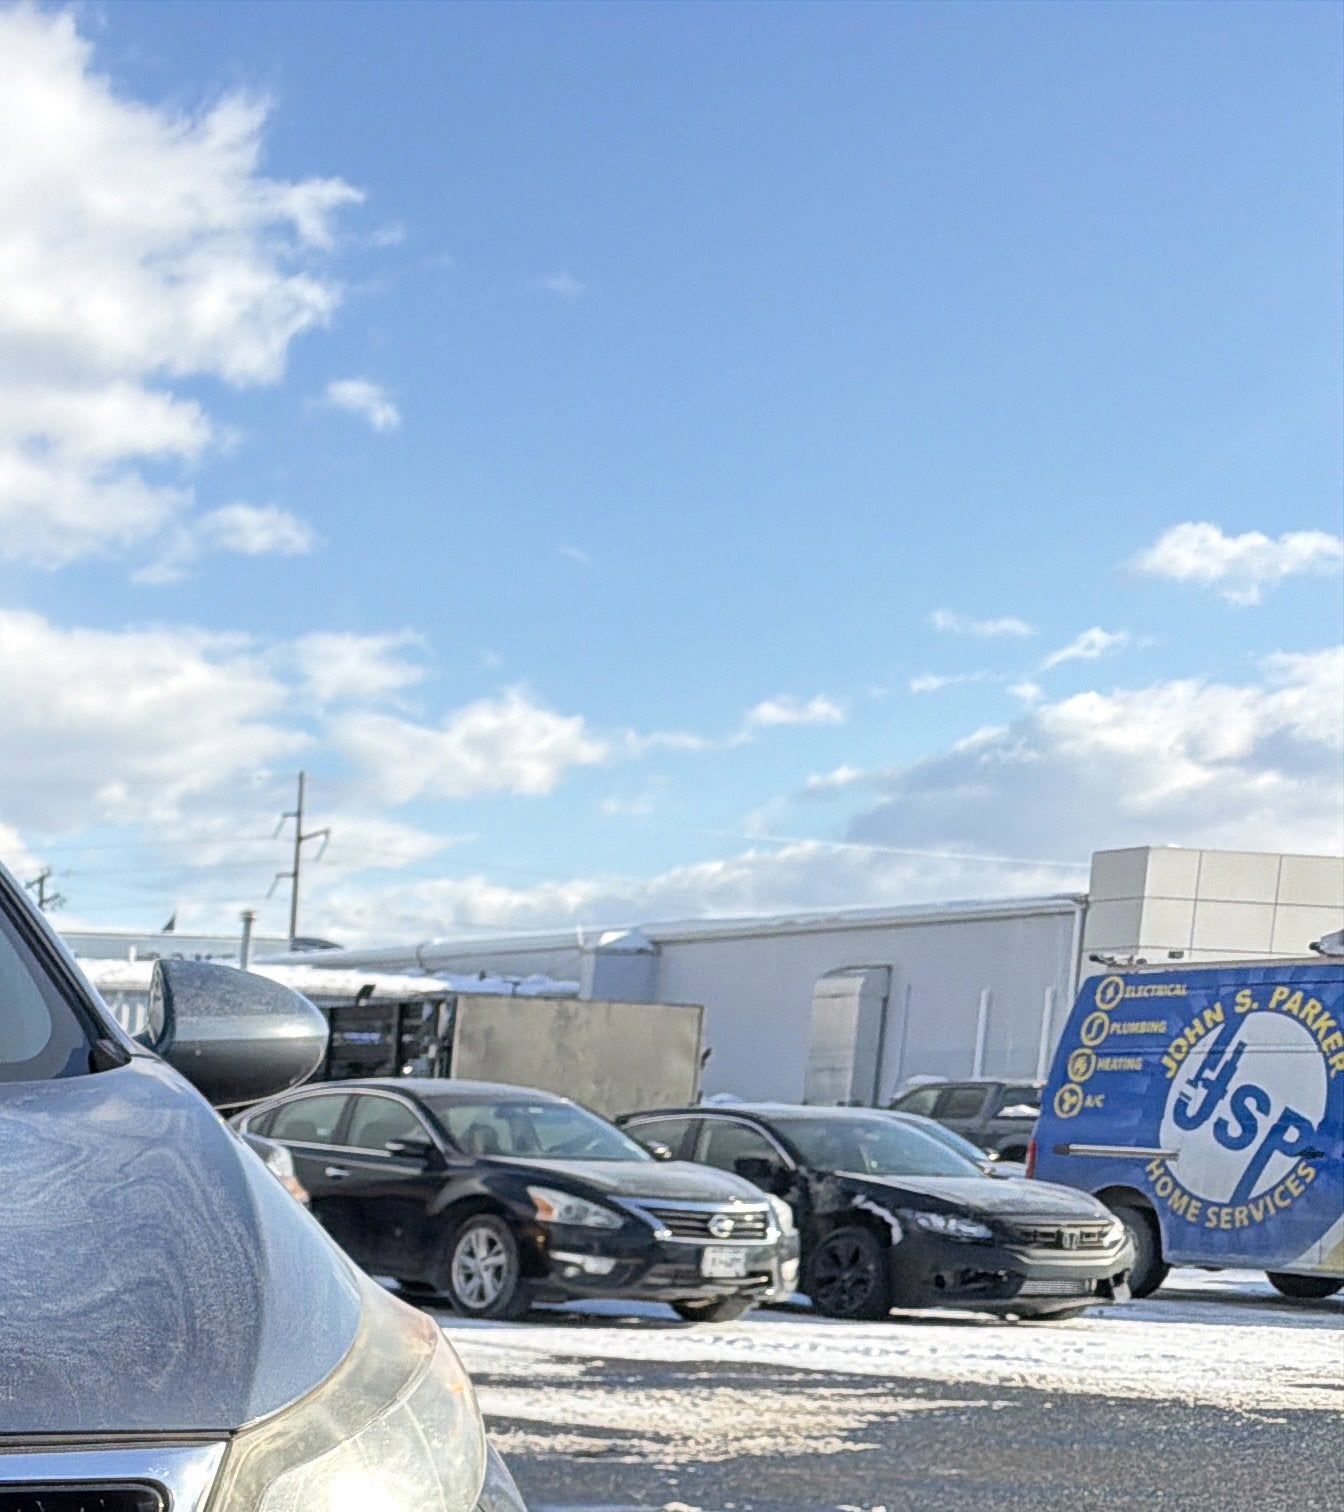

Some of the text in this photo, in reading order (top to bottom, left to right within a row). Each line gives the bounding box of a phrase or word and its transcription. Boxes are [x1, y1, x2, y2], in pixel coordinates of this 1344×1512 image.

[1110, 1020, 1167, 1034] PLUMBING
[1162, 986, 1344, 1079] JOHN S. PARKER
[1096, 1057, 1143, 1071] HEATING
[1145, 1158, 1317, 1230] HOME SERVICES
